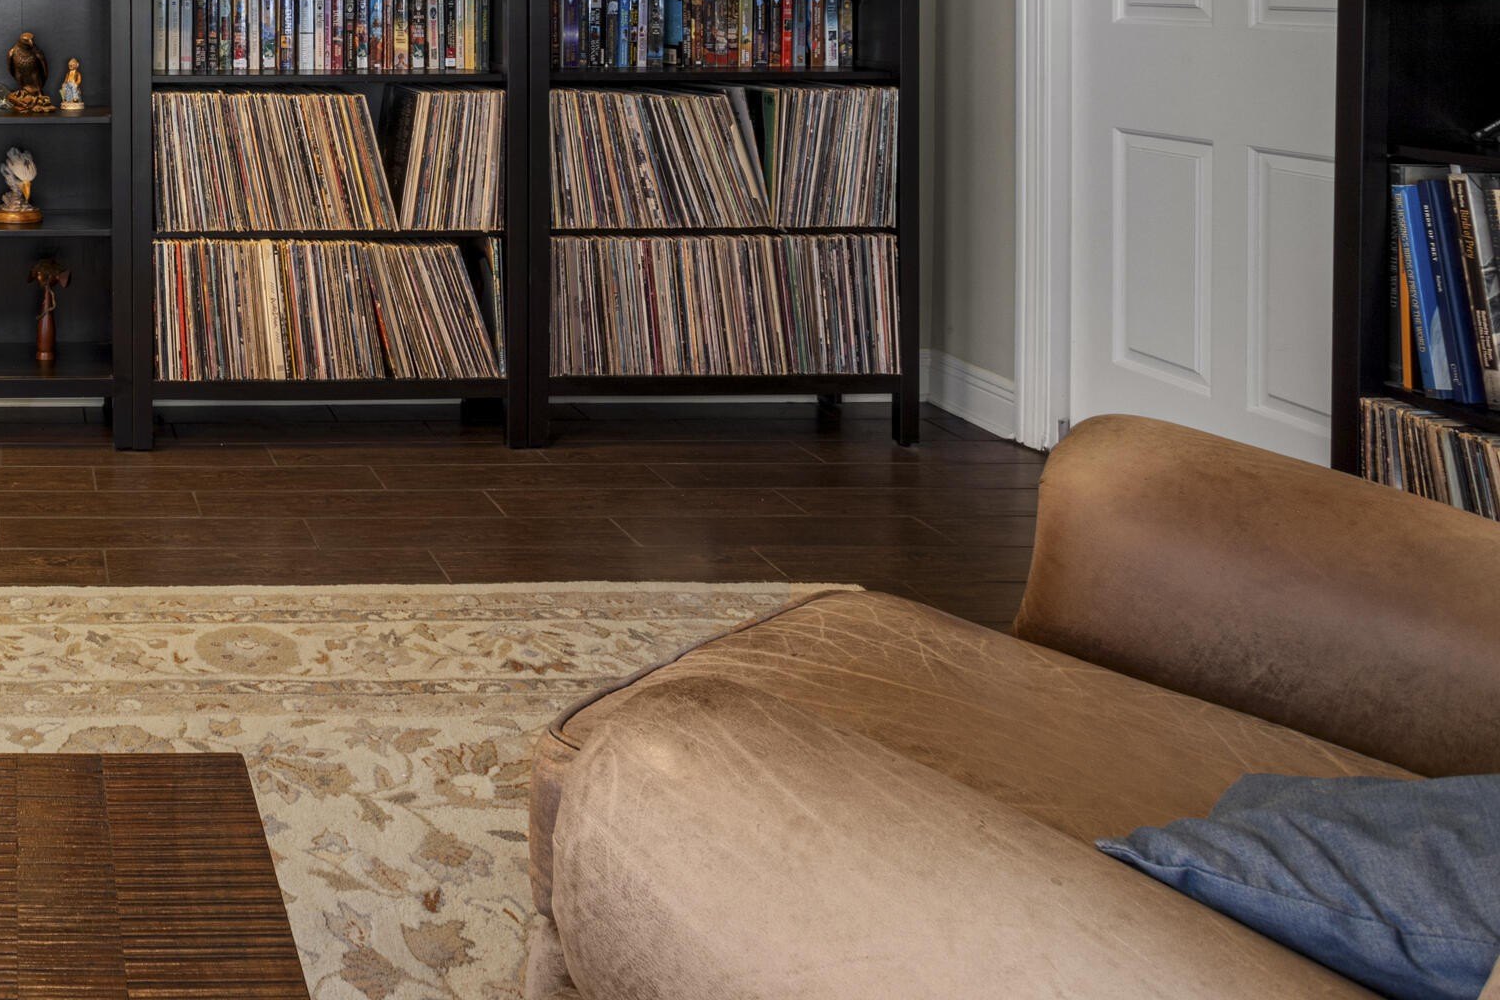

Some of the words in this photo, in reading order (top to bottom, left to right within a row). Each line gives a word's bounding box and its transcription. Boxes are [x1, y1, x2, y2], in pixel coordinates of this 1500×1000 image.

[1423, 204, 1432, 227] BIRDS
[1430, 242, 1438, 262] PREY
[1459, 209, 1471, 230] Birds
[1465, 240, 1475, 260] Prey
[1404, 248, 1413, 269] BIRDS
[1409, 280, 1418, 299] PREY
[1414, 310, 1422, 325] THE
[1416, 326, 1426, 353] WORLD
